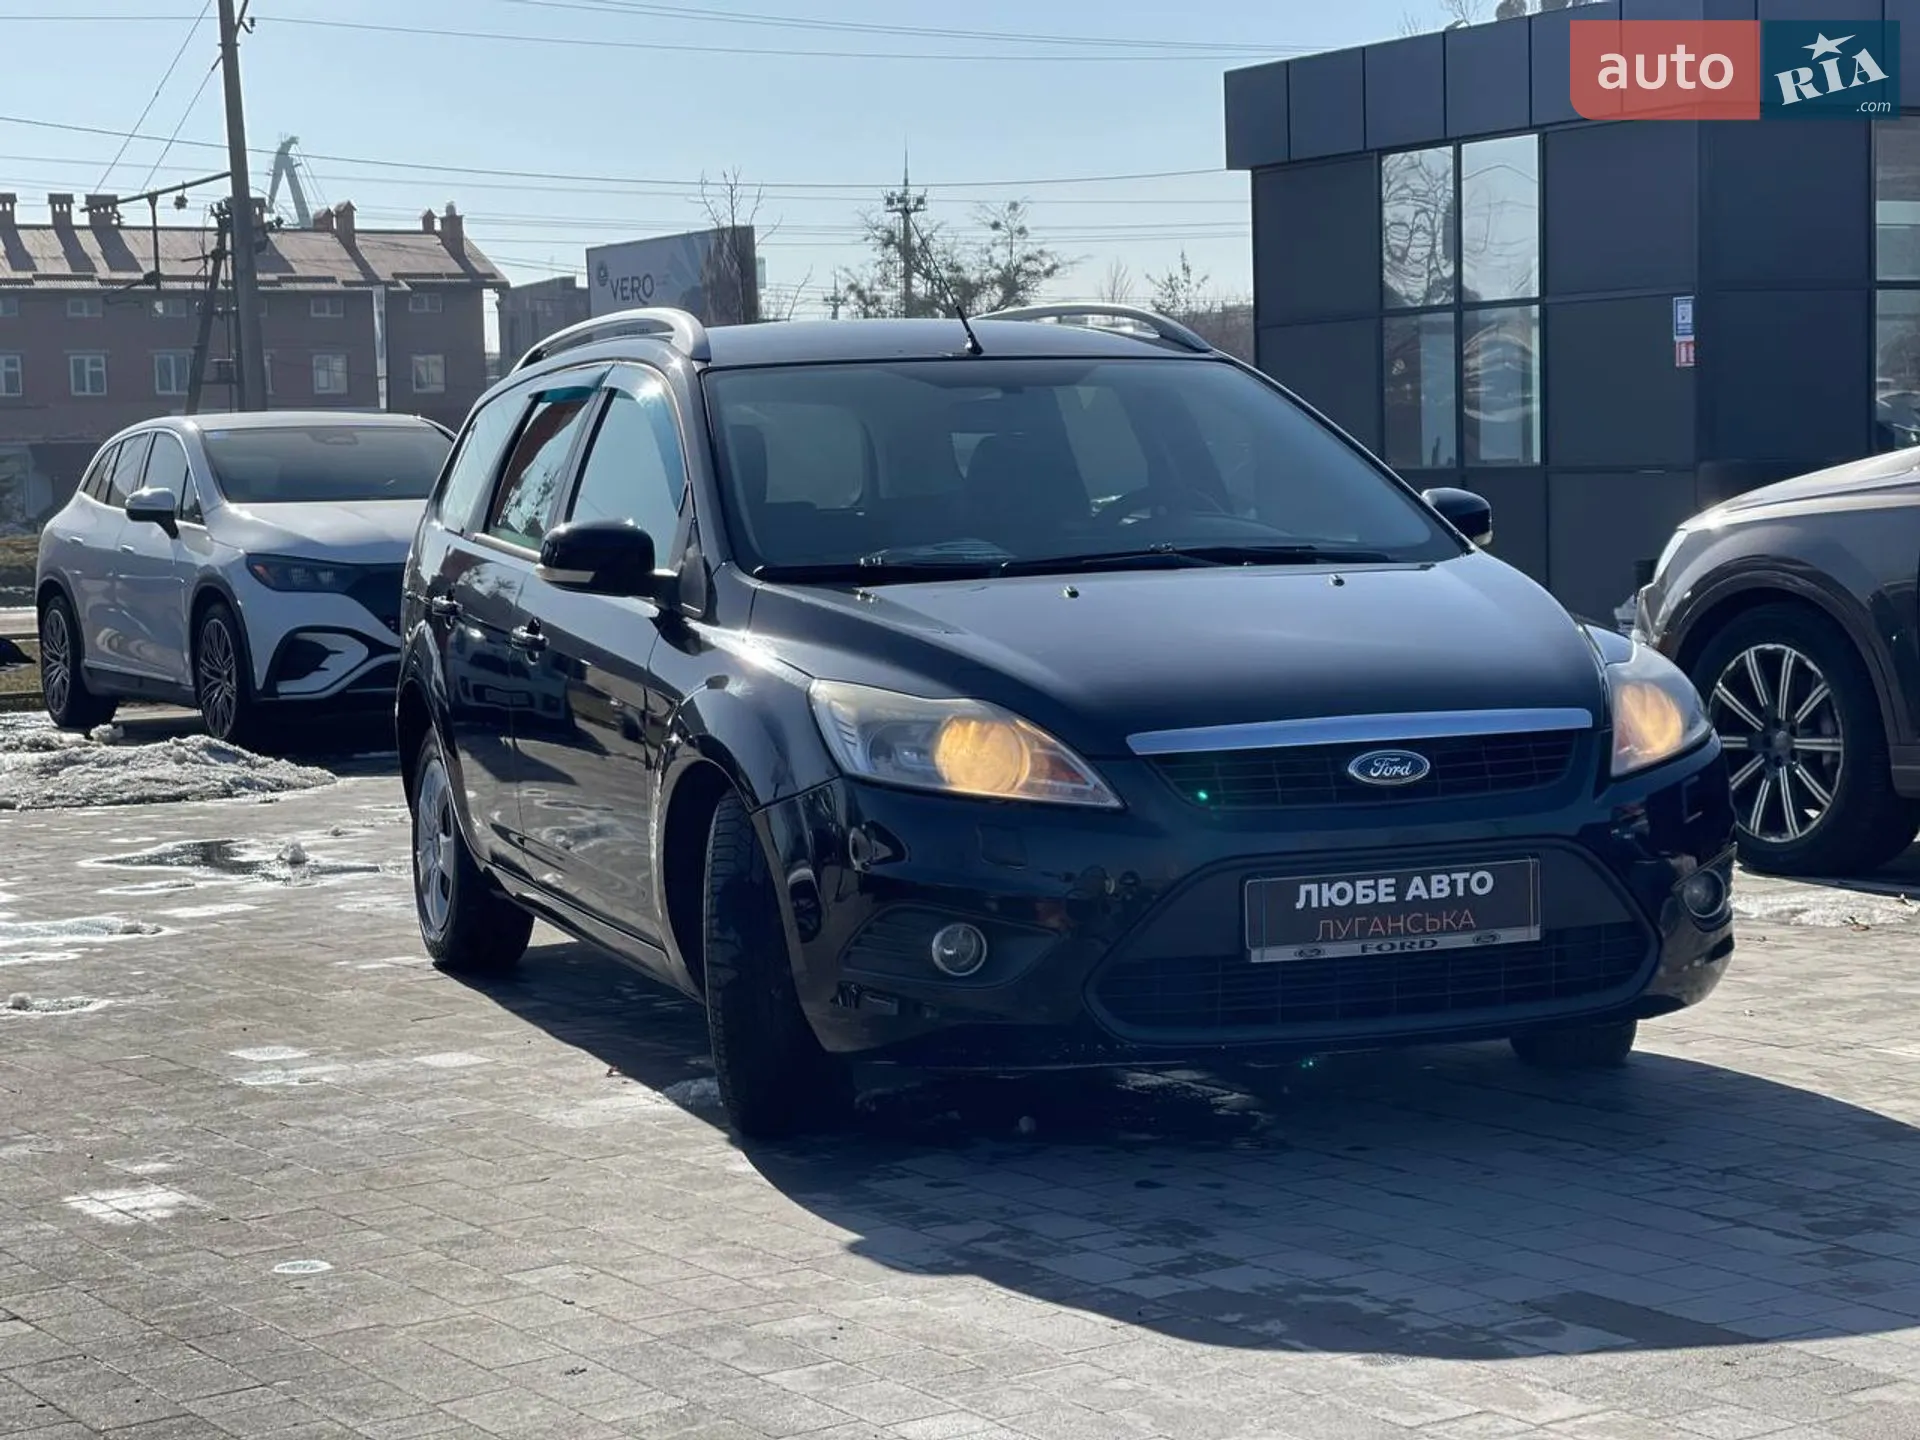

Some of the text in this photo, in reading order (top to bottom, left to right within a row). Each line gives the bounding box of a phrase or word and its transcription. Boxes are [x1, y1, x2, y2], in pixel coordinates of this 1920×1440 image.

[610, 273, 654, 304] VERO
[1369, 757, 1412, 778] Ford
[1295, 871, 1494, 910] ЛЮБЕ АВТО
[1315, 908, 1477, 942] ЛУГАНСЬКА
[1360, 938, 1439, 955] FORD
